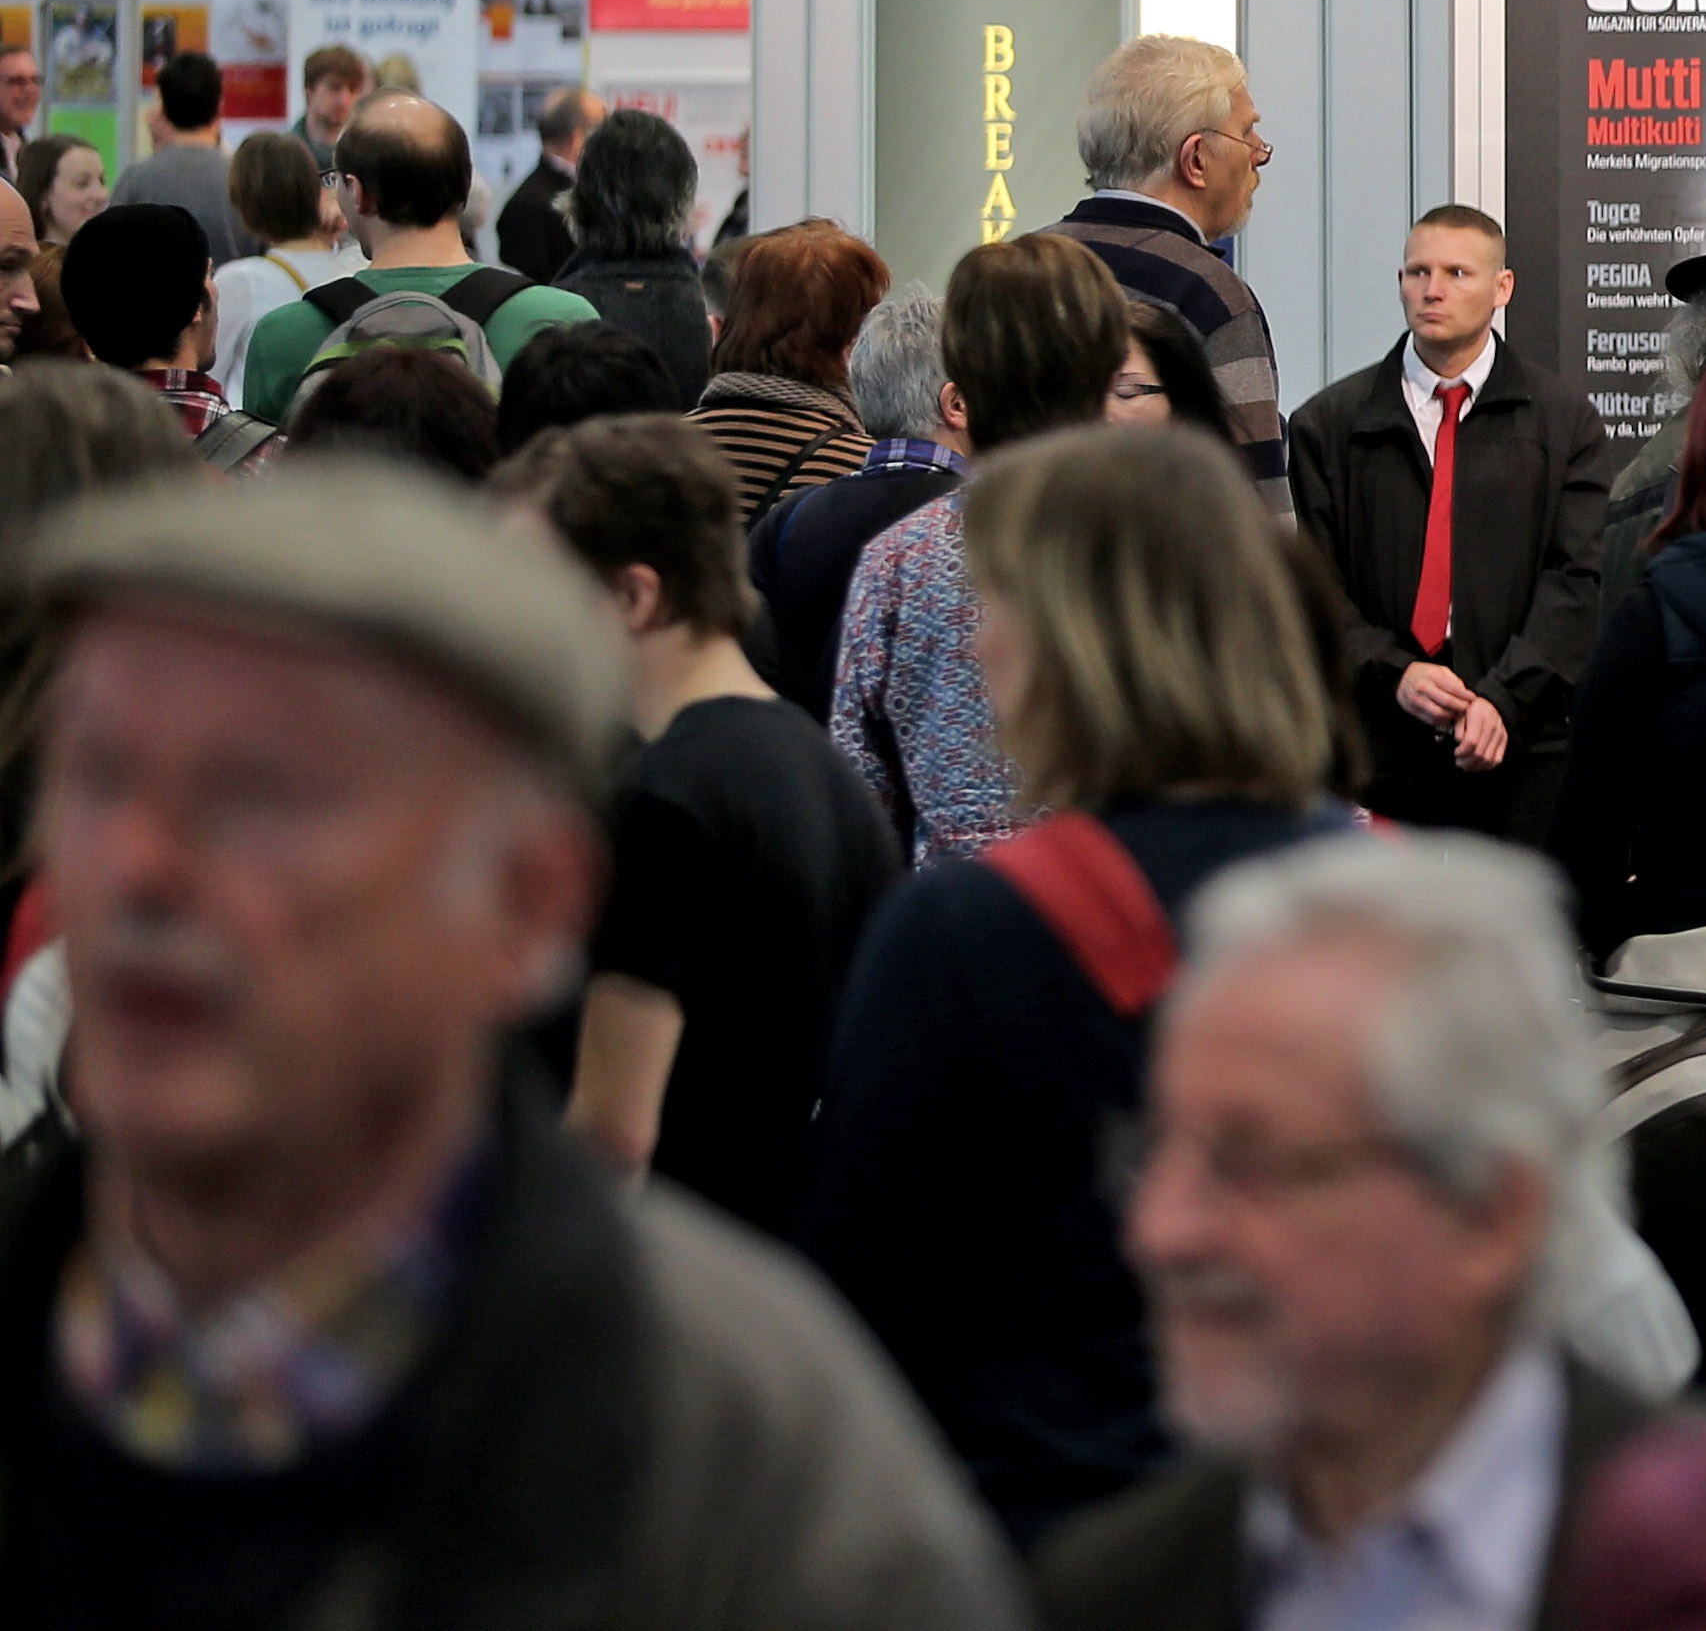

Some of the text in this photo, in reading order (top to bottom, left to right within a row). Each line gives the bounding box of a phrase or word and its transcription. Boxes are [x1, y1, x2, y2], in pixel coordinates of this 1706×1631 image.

[1587, 15, 1634, 32] MAGAZIN
[1636, 14, 1656, 32] FÜR
[1588, 57, 1701, 109] Mutti
[1587, 116, 1700, 146] Multikulti
[1586, 153, 1632, 168] Merkels
[1587, 200, 1640, 226] Tugce
[1587, 226, 1705, 244] Die verhöhnten Opfer
[1587, 264, 1651, 287] PEGIDA
[1587, 292, 1634, 308] Dresden
[1636, 292, 1669, 308] wehrt
[1587, 356, 1664, 374] Rambo gegen
